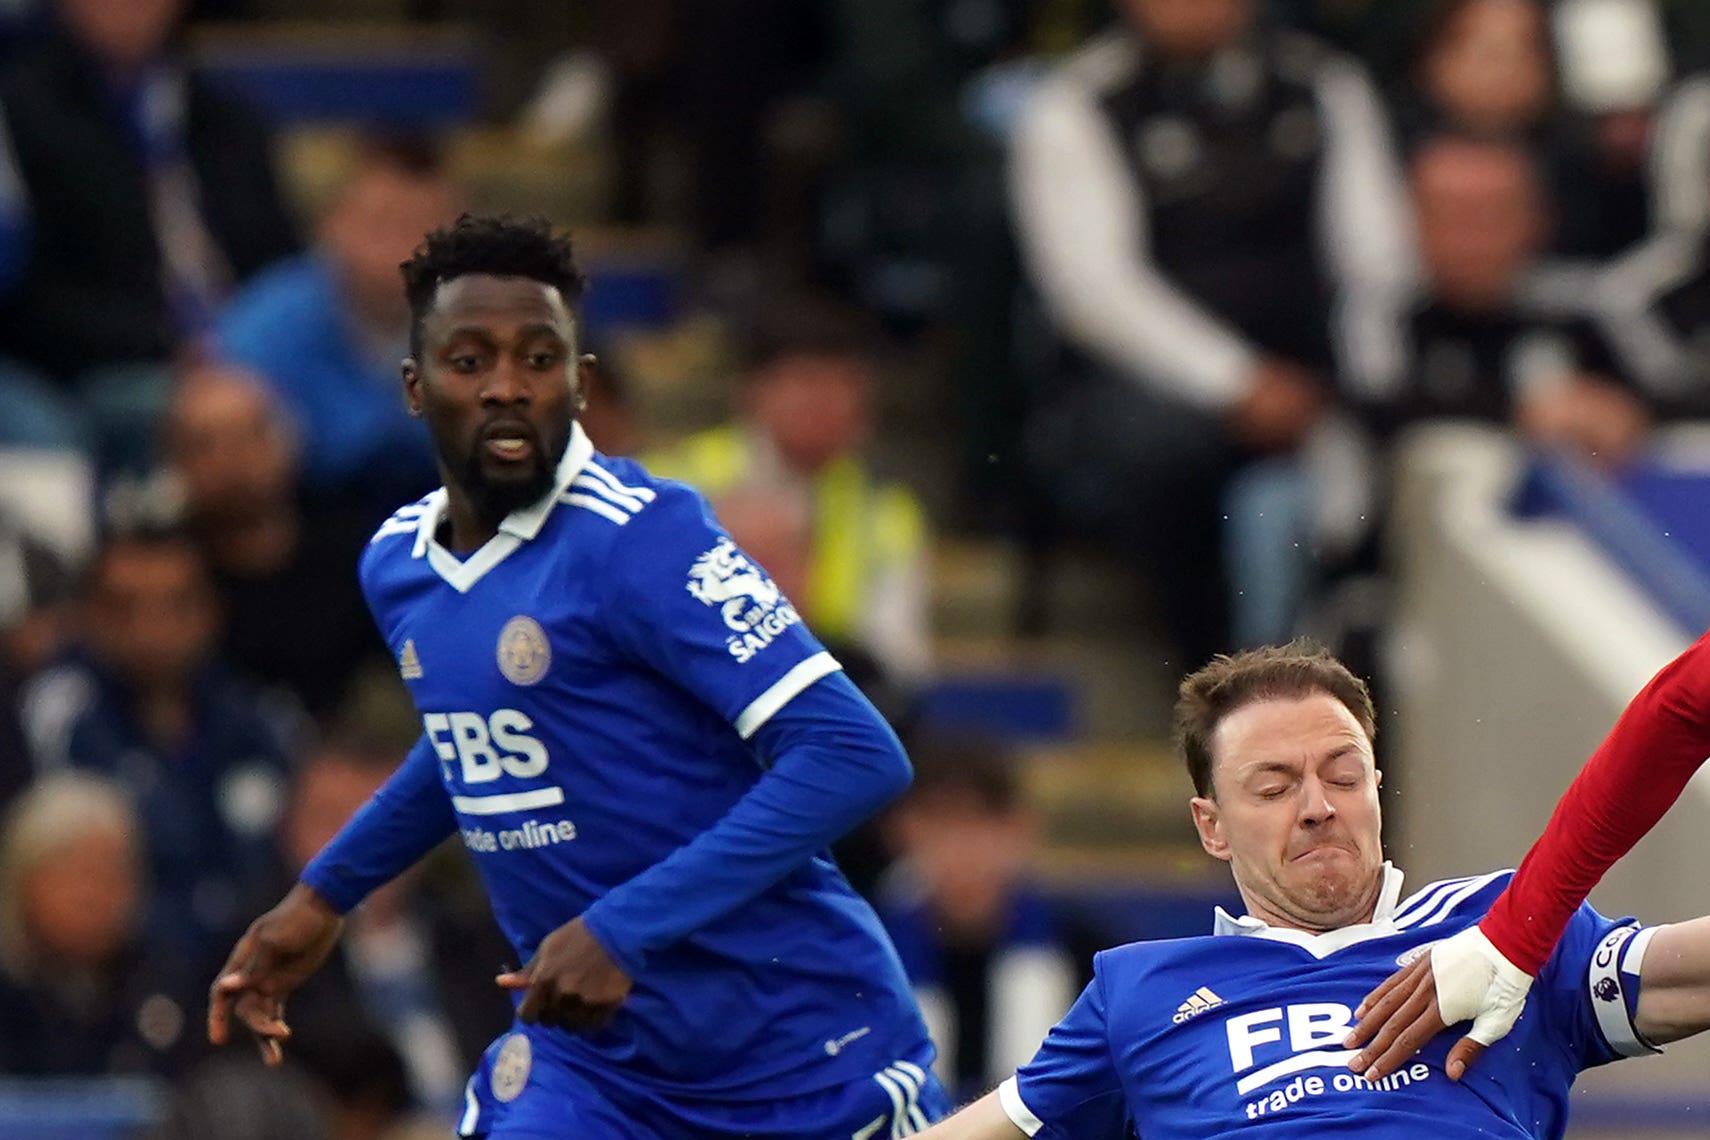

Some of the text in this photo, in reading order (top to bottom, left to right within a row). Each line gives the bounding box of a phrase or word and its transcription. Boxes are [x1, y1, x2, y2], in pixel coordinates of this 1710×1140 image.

[423, 709, 550, 784] FBS
[498, 819, 576, 851] online
[1226, 1002, 1356, 1073] FB
[1245, 1075, 1324, 1120] trade
